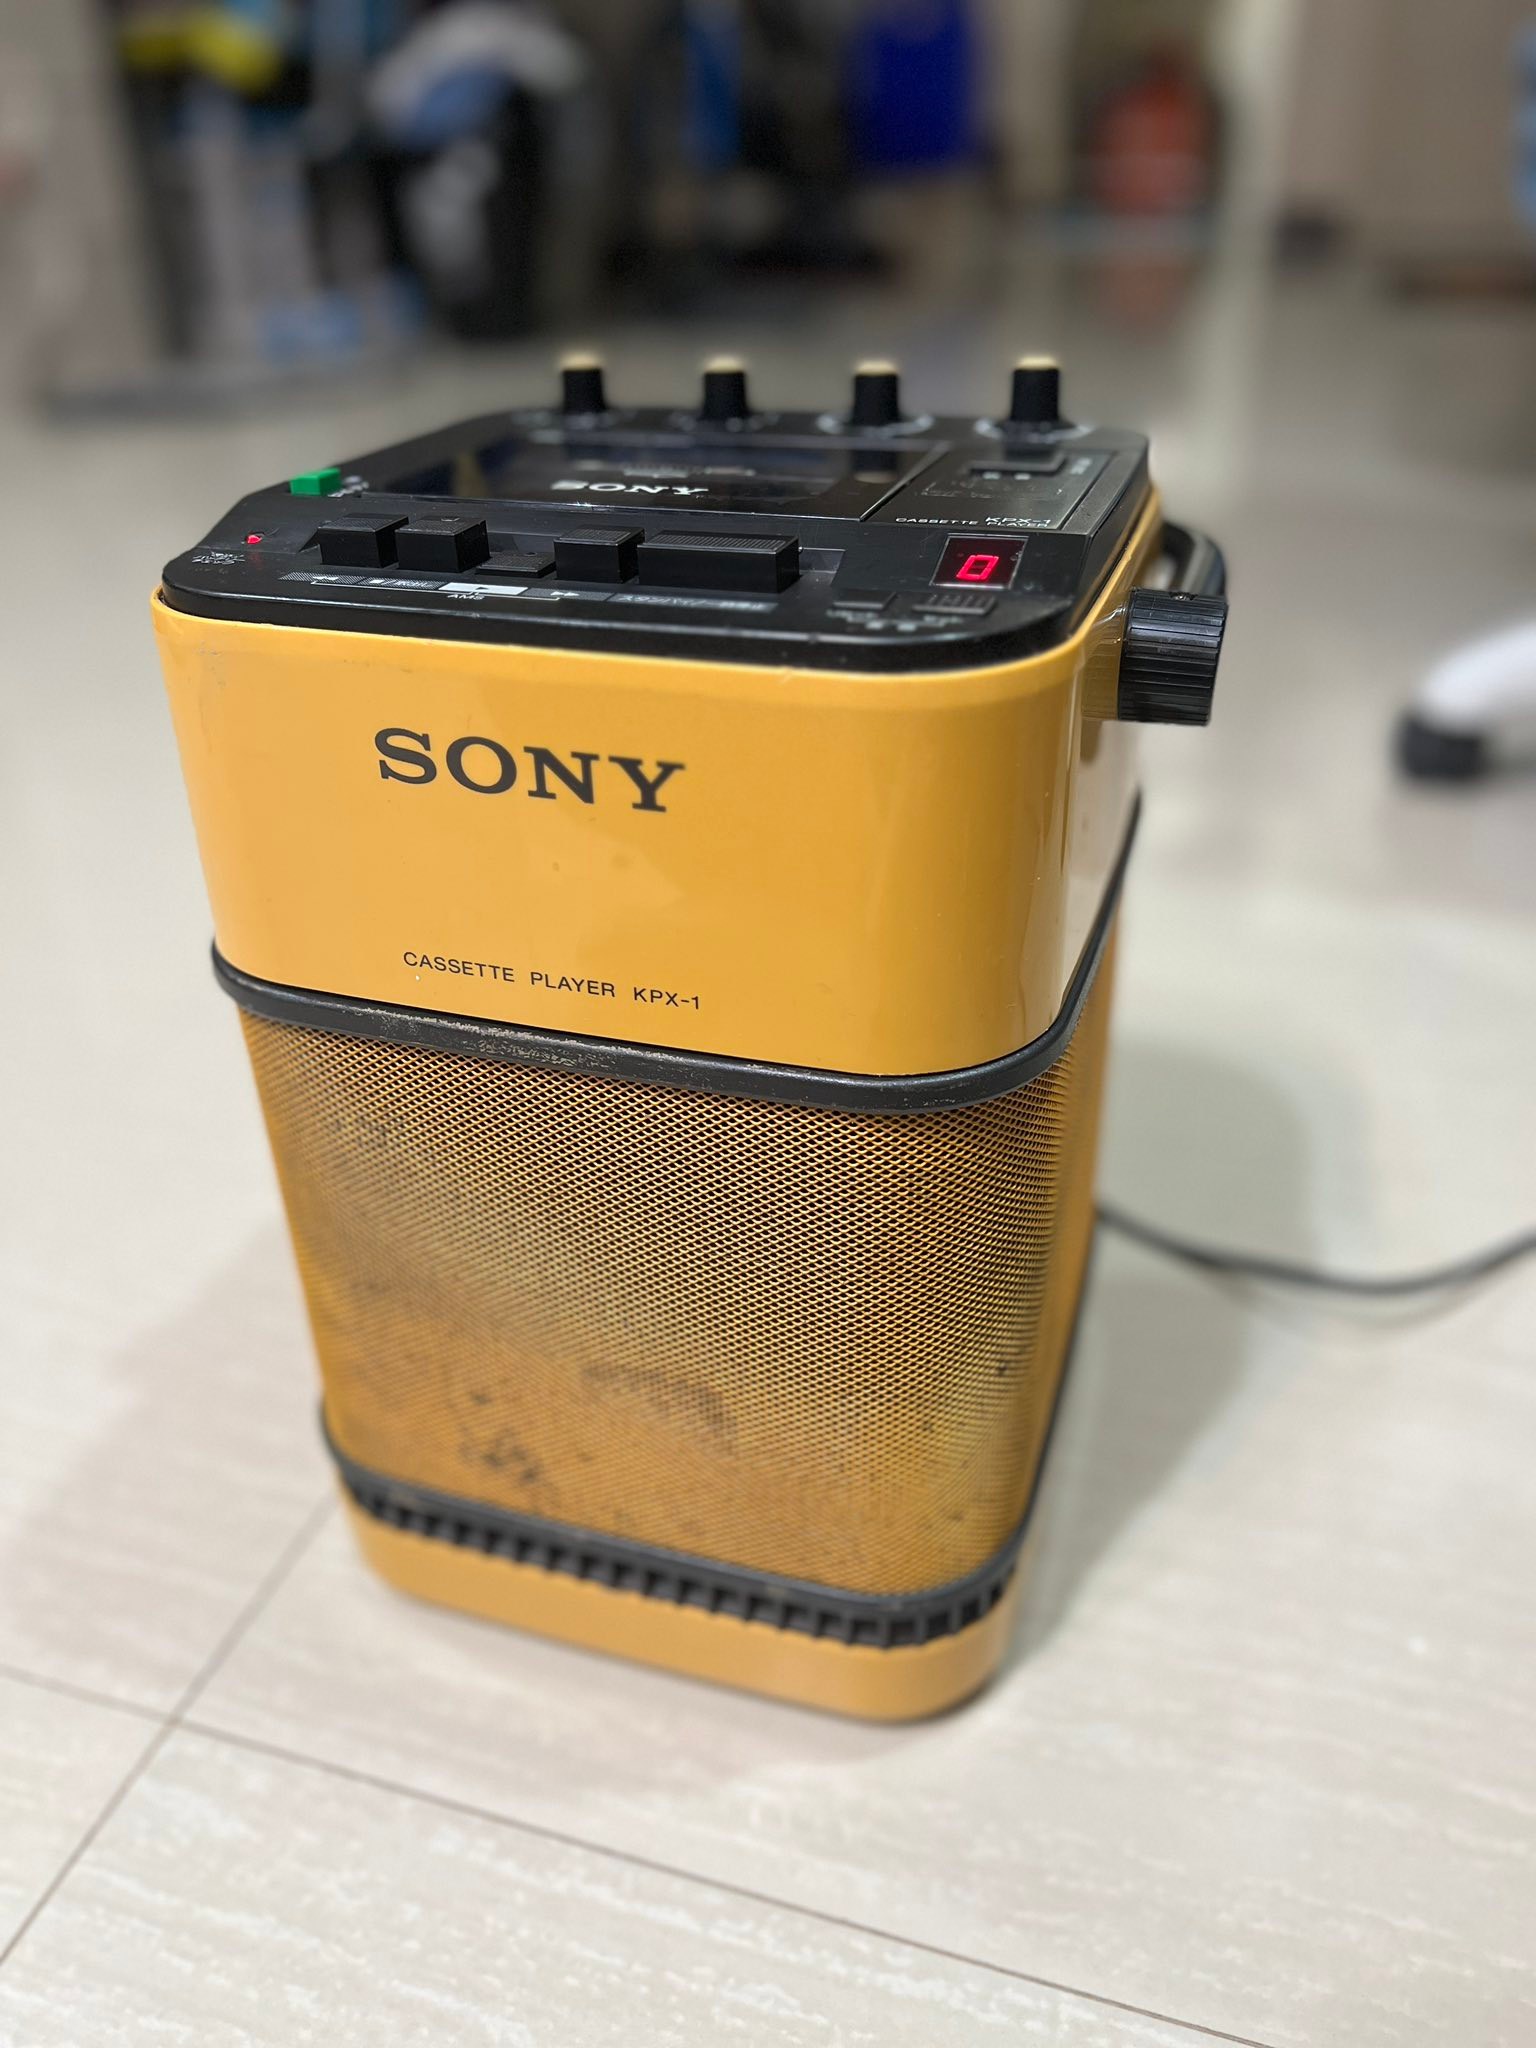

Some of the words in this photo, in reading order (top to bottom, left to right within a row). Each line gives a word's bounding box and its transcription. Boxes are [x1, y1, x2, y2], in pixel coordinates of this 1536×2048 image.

[895, 517, 979, 525] CASSETTE
[374, 727, 686, 813] SONY
[403, 951, 515, 982] CASSETTE
[531, 971, 616, 998] PLAYER
[633, 986, 701, 1010] KPX-1
